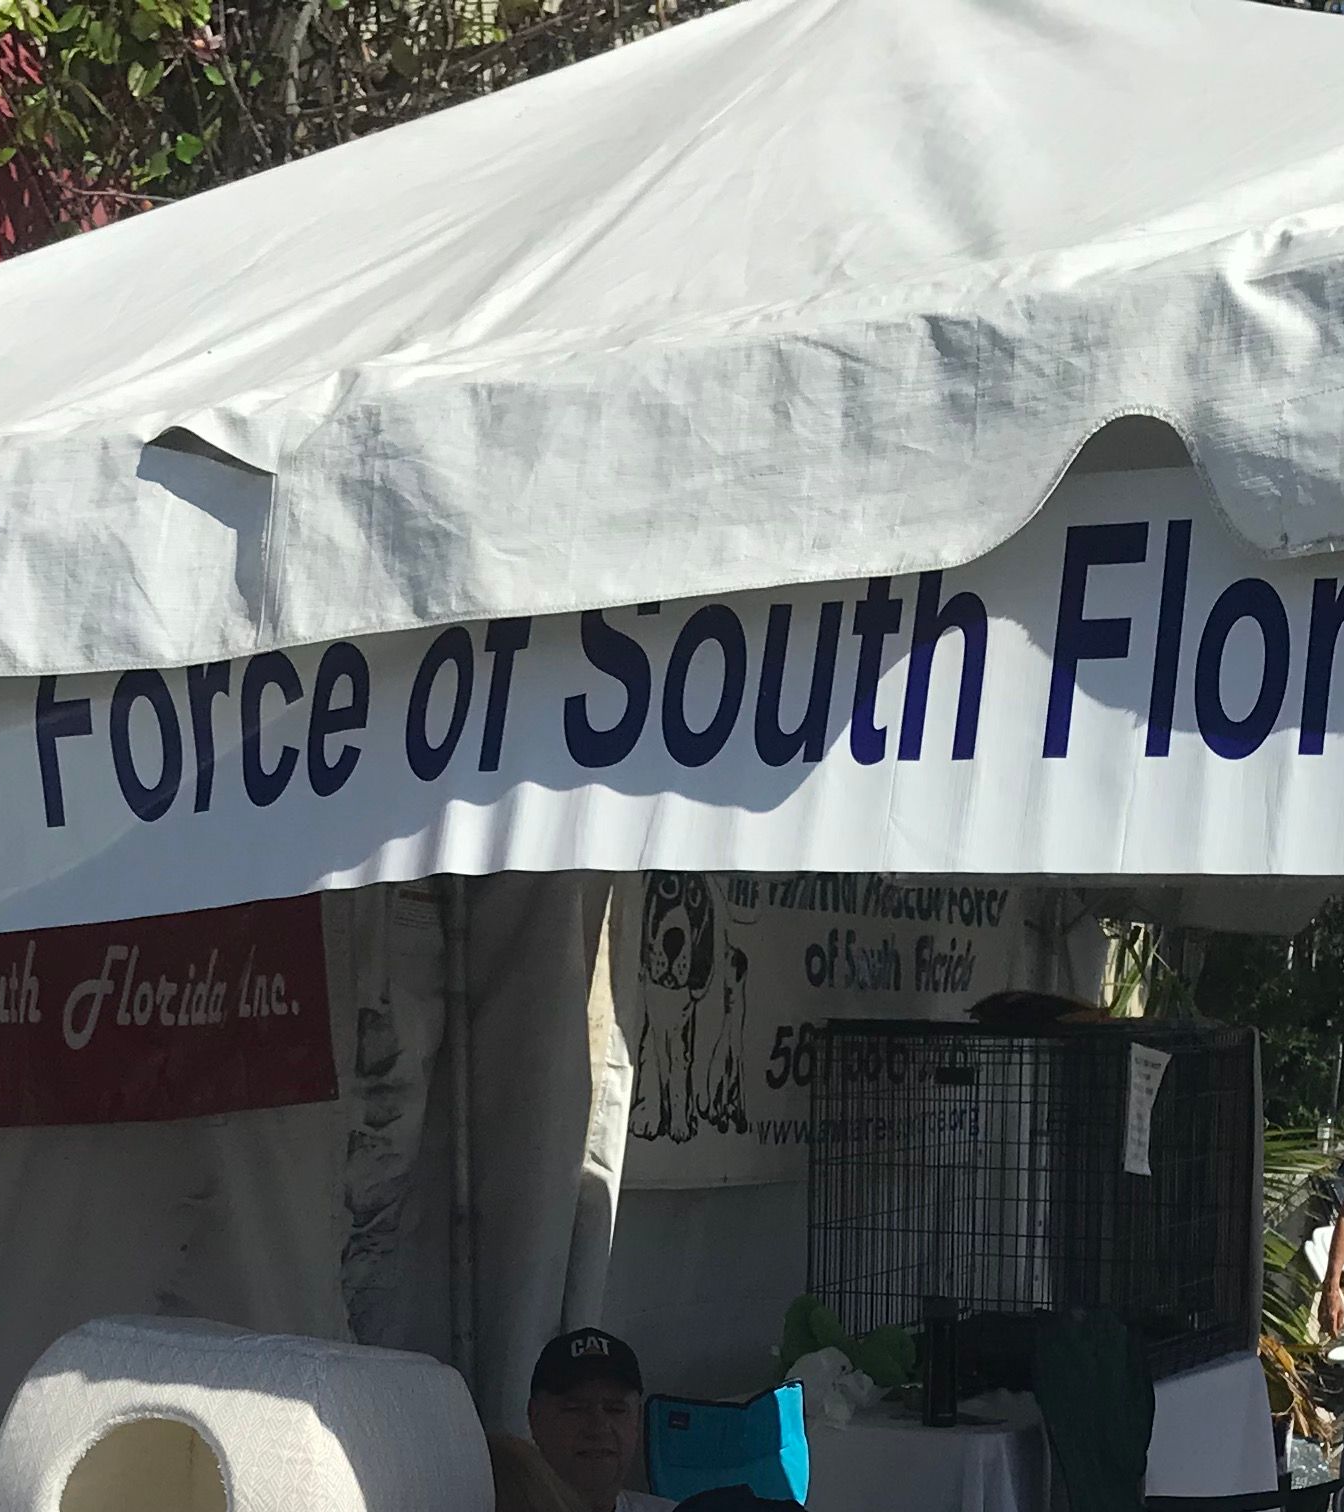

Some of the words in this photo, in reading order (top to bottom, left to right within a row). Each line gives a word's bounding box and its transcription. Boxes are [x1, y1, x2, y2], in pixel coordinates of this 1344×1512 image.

[34, 639, 372, 829] Force
[404, 616, 532, 783] of
[564, 570, 990, 770] South
[570, 1336, 610, 1358] CAT
